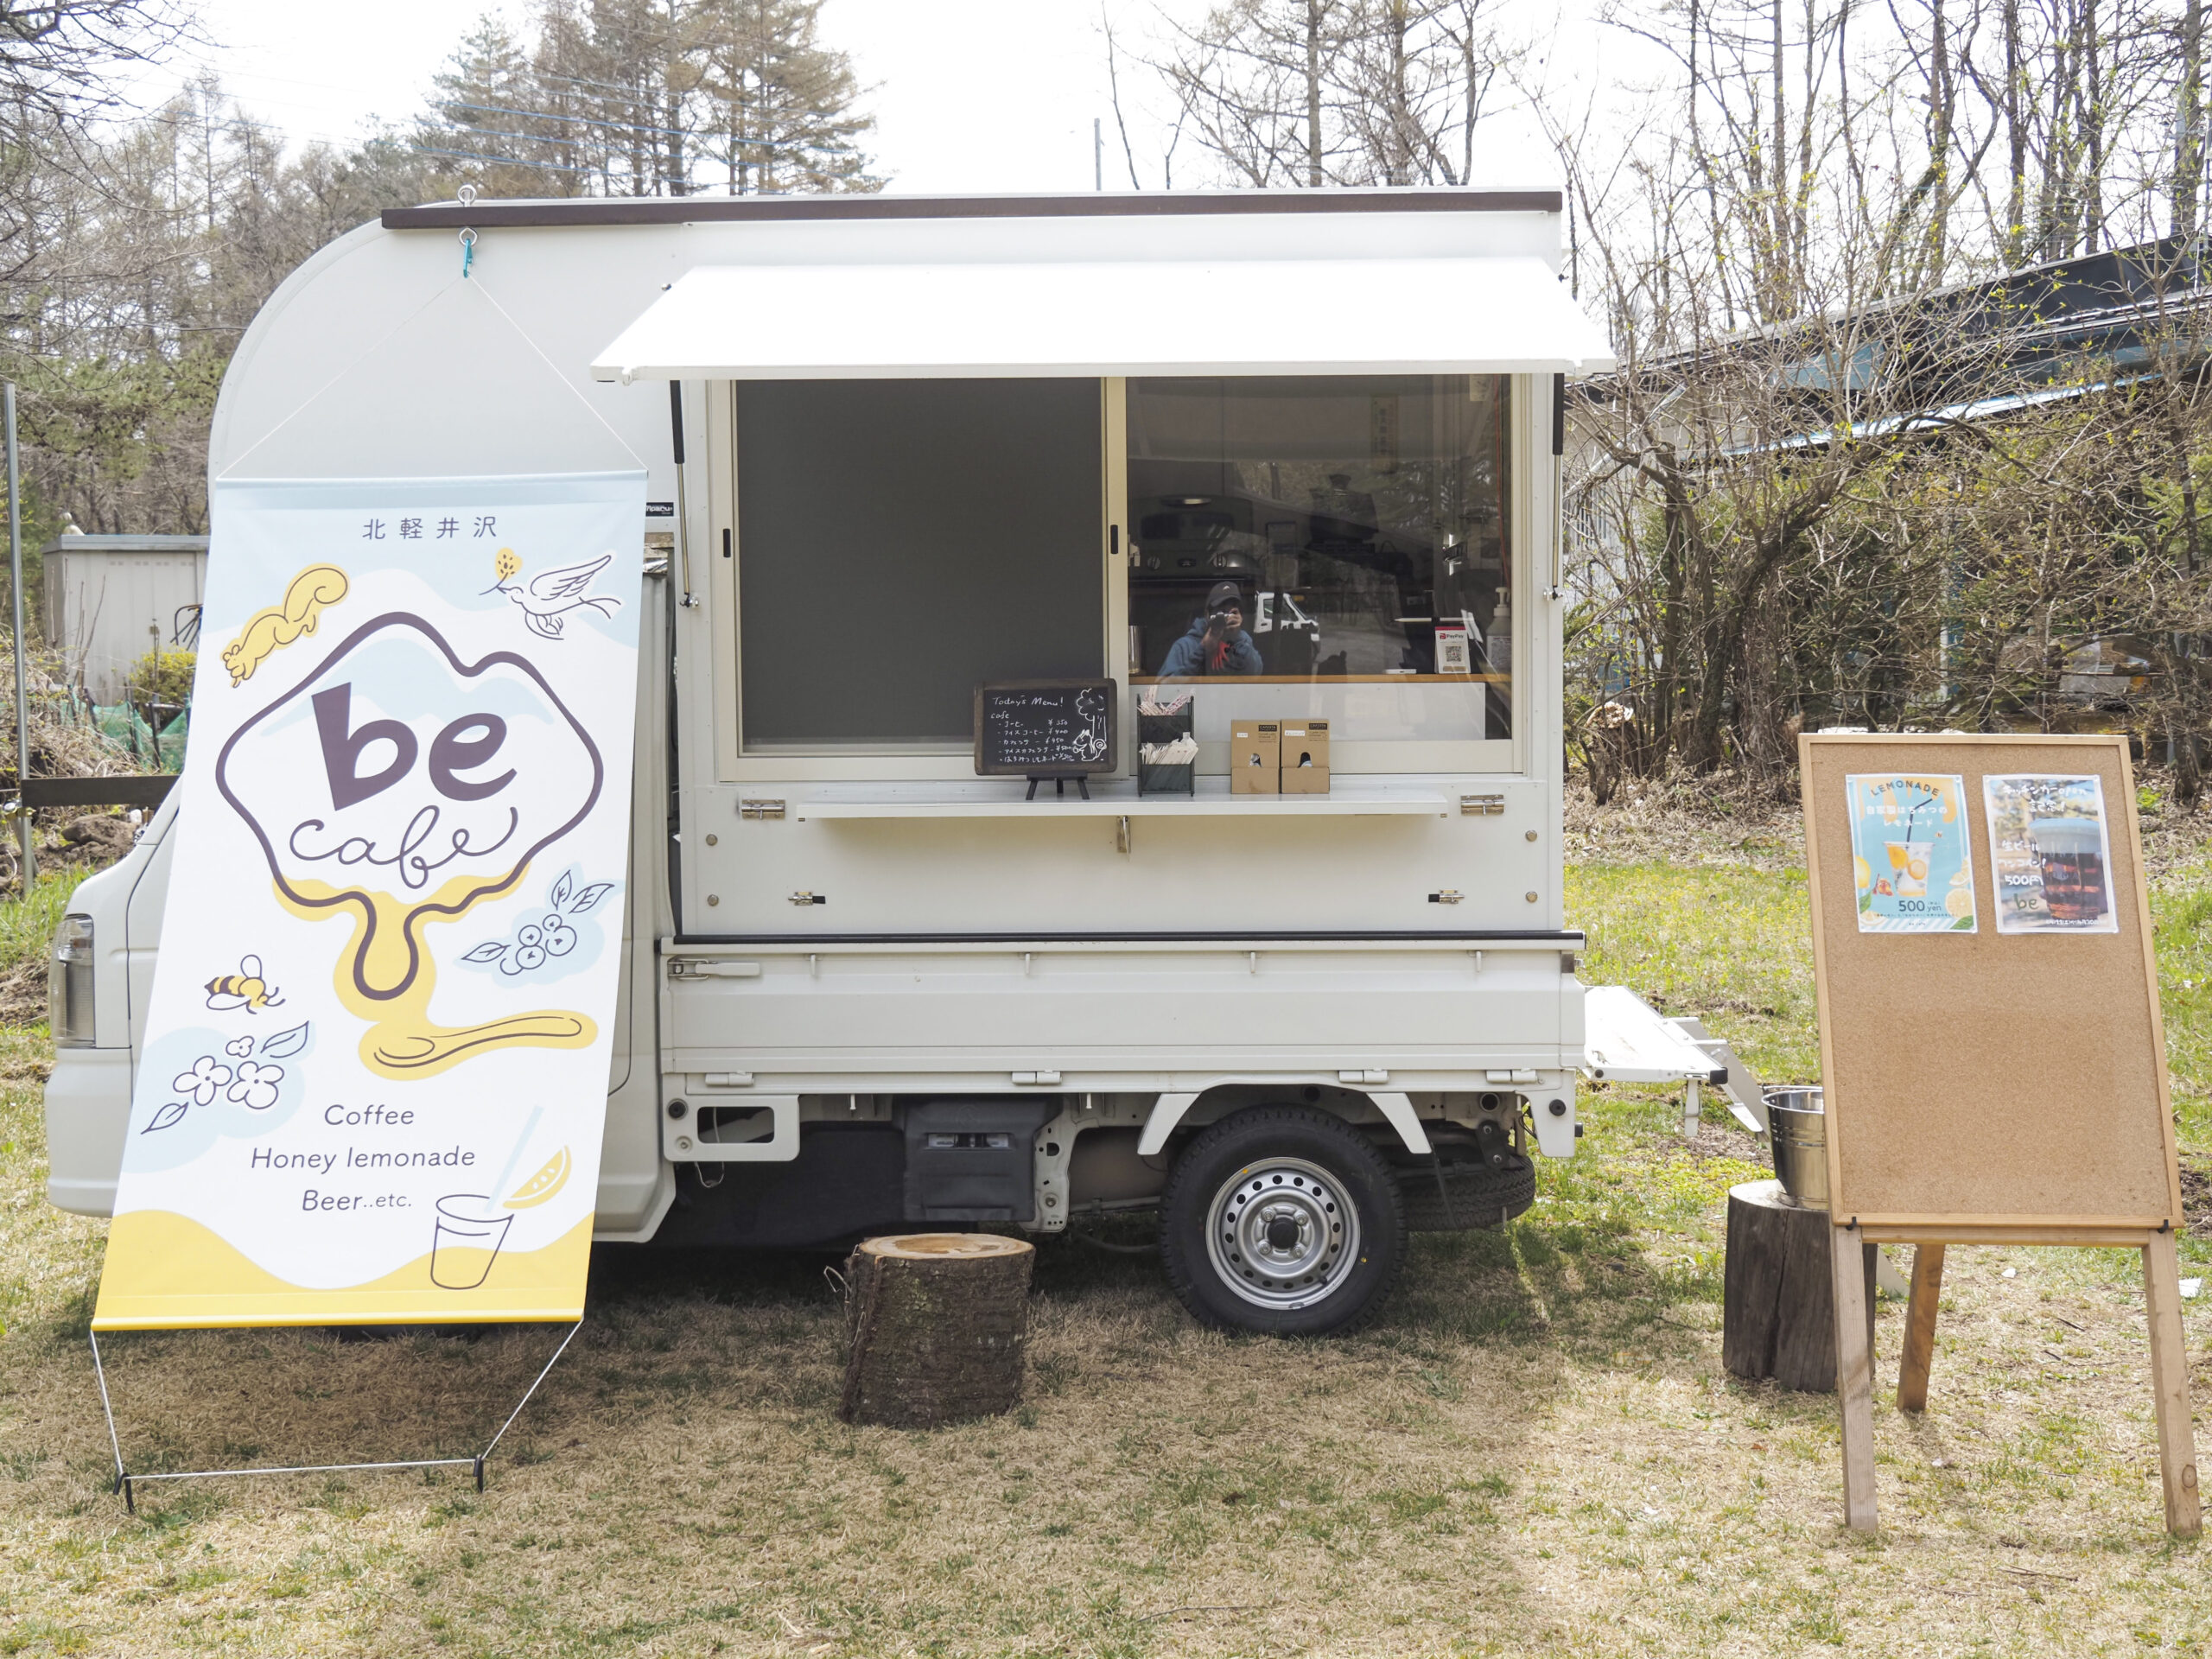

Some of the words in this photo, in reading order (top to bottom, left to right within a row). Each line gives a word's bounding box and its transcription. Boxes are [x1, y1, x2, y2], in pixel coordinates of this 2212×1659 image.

[362, 516, 497, 540] 北軽井沢
[1031, 696, 1064, 707] Menu!
[311, 682, 518, 811] be
[1871, 780, 1941, 797] LEMONADE
[289, 805, 518, 890] cafe
[2004, 874, 2044, 886] 500円
[1898, 899, 1925, 912] 500
[2013, 893, 2040, 911] be
[324, 1104, 415, 1126] Coffee
[251, 1147, 337, 1175] Honey
[346, 1145, 476, 1168] lemonade
